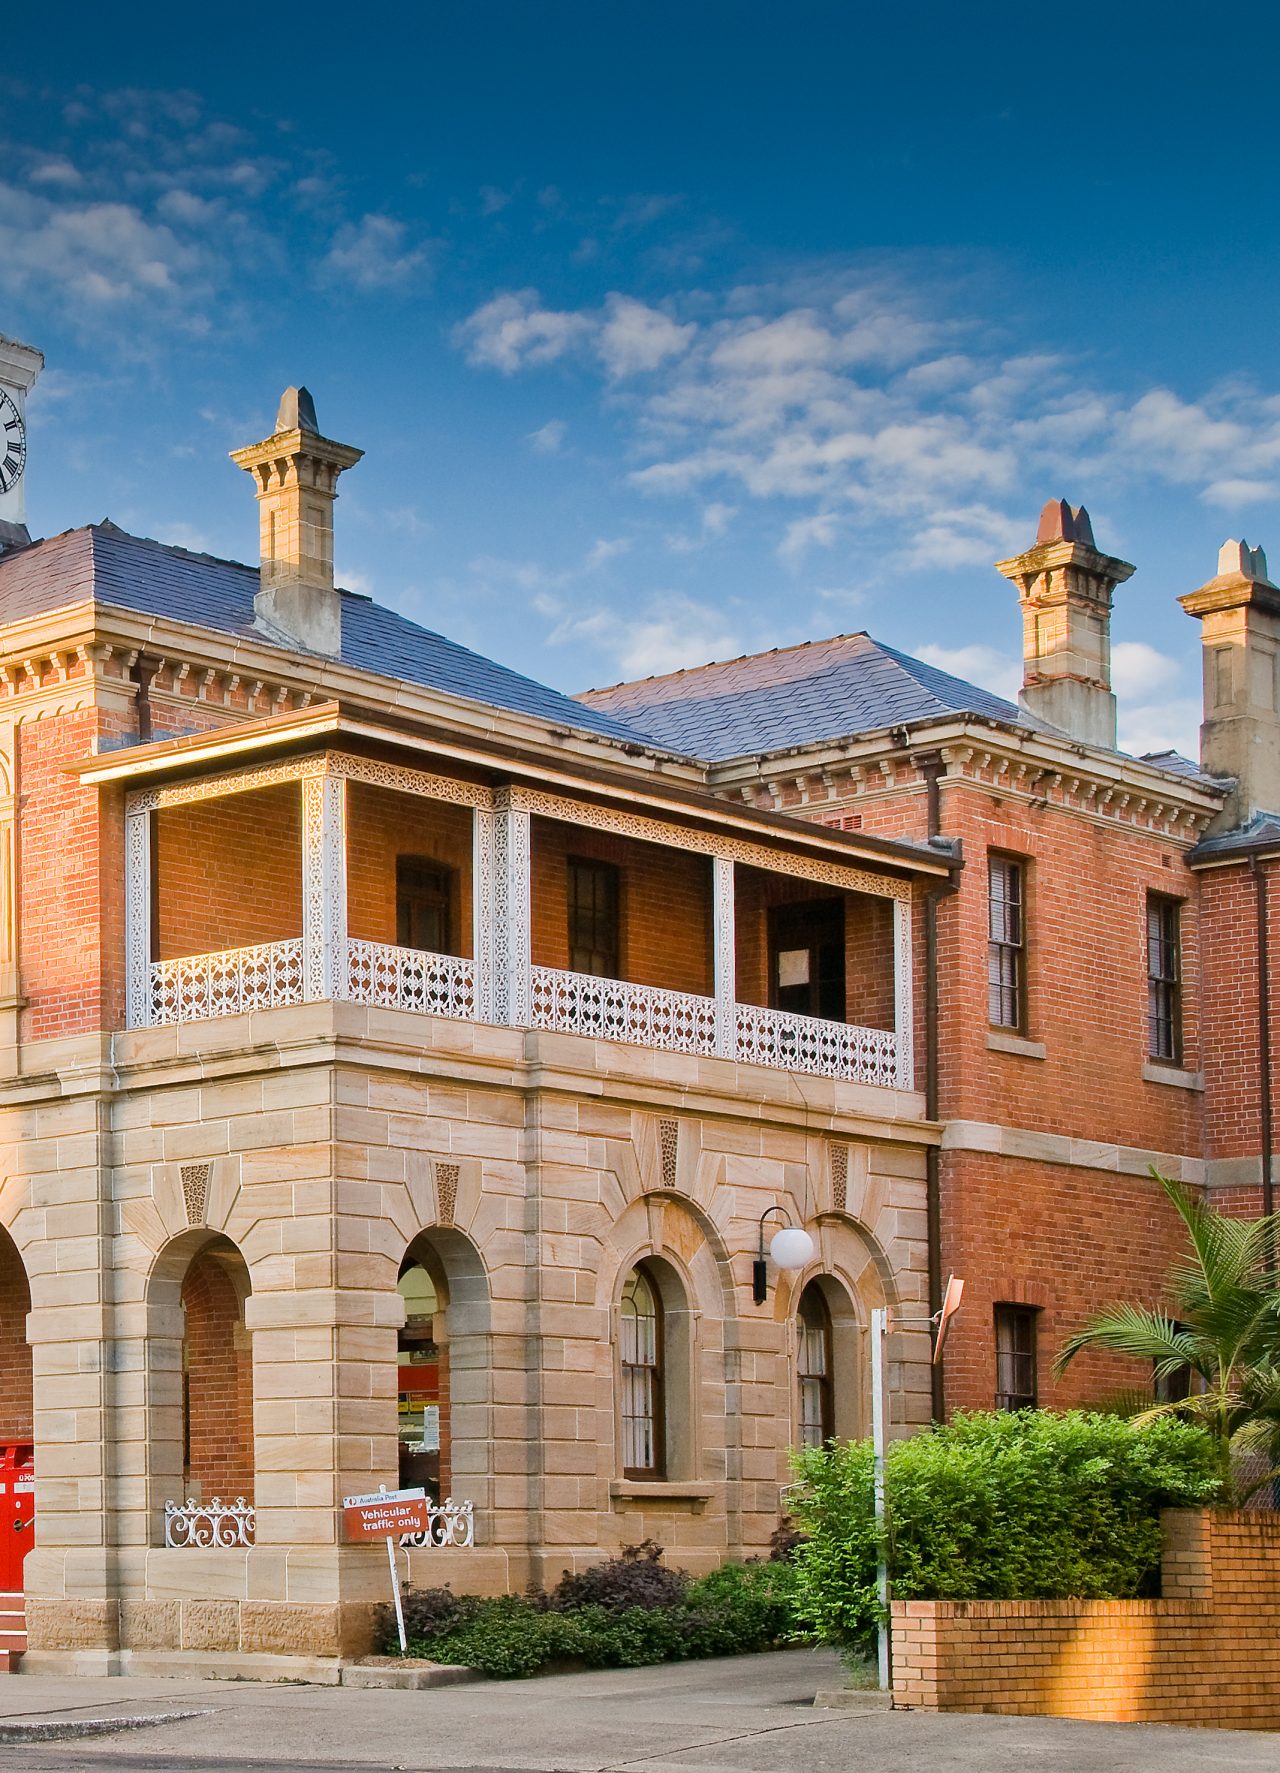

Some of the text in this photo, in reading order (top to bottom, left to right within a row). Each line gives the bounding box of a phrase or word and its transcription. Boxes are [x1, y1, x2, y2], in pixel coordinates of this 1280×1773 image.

[359, 1495, 384, 1504] Australia
[360, 1507, 412, 1521] Vehicular
[362, 1516, 421, 1531] traffic only
